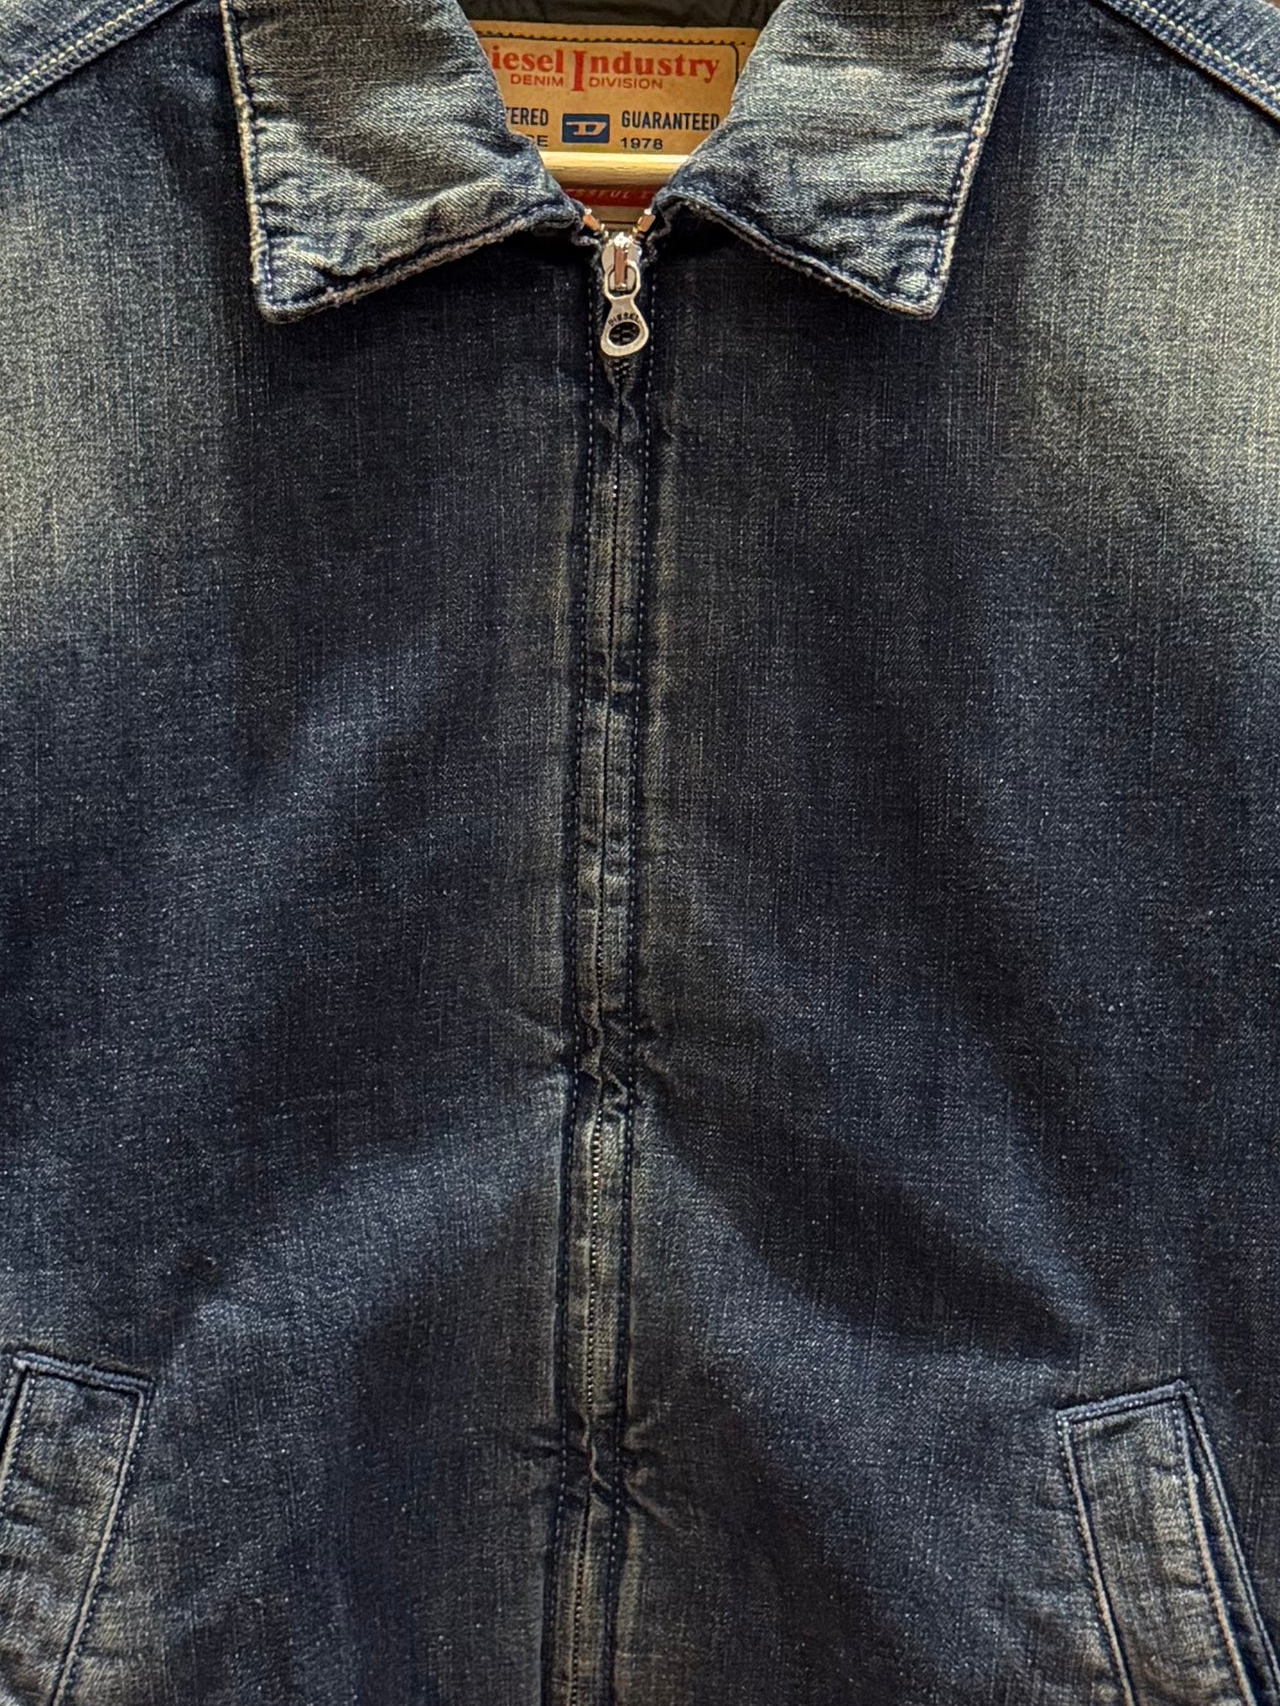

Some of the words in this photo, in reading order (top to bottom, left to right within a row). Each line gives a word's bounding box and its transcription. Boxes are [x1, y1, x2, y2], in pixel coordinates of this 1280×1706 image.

[491, 45, 564, 74] iesel
[571, 50, 720, 92] Industry
[510, 73, 564, 87] DENIM
[589, 76, 663, 90] DIVISION
[621, 109, 720, 131] GUARANTEED
[621, 136, 663, 150] 1978
